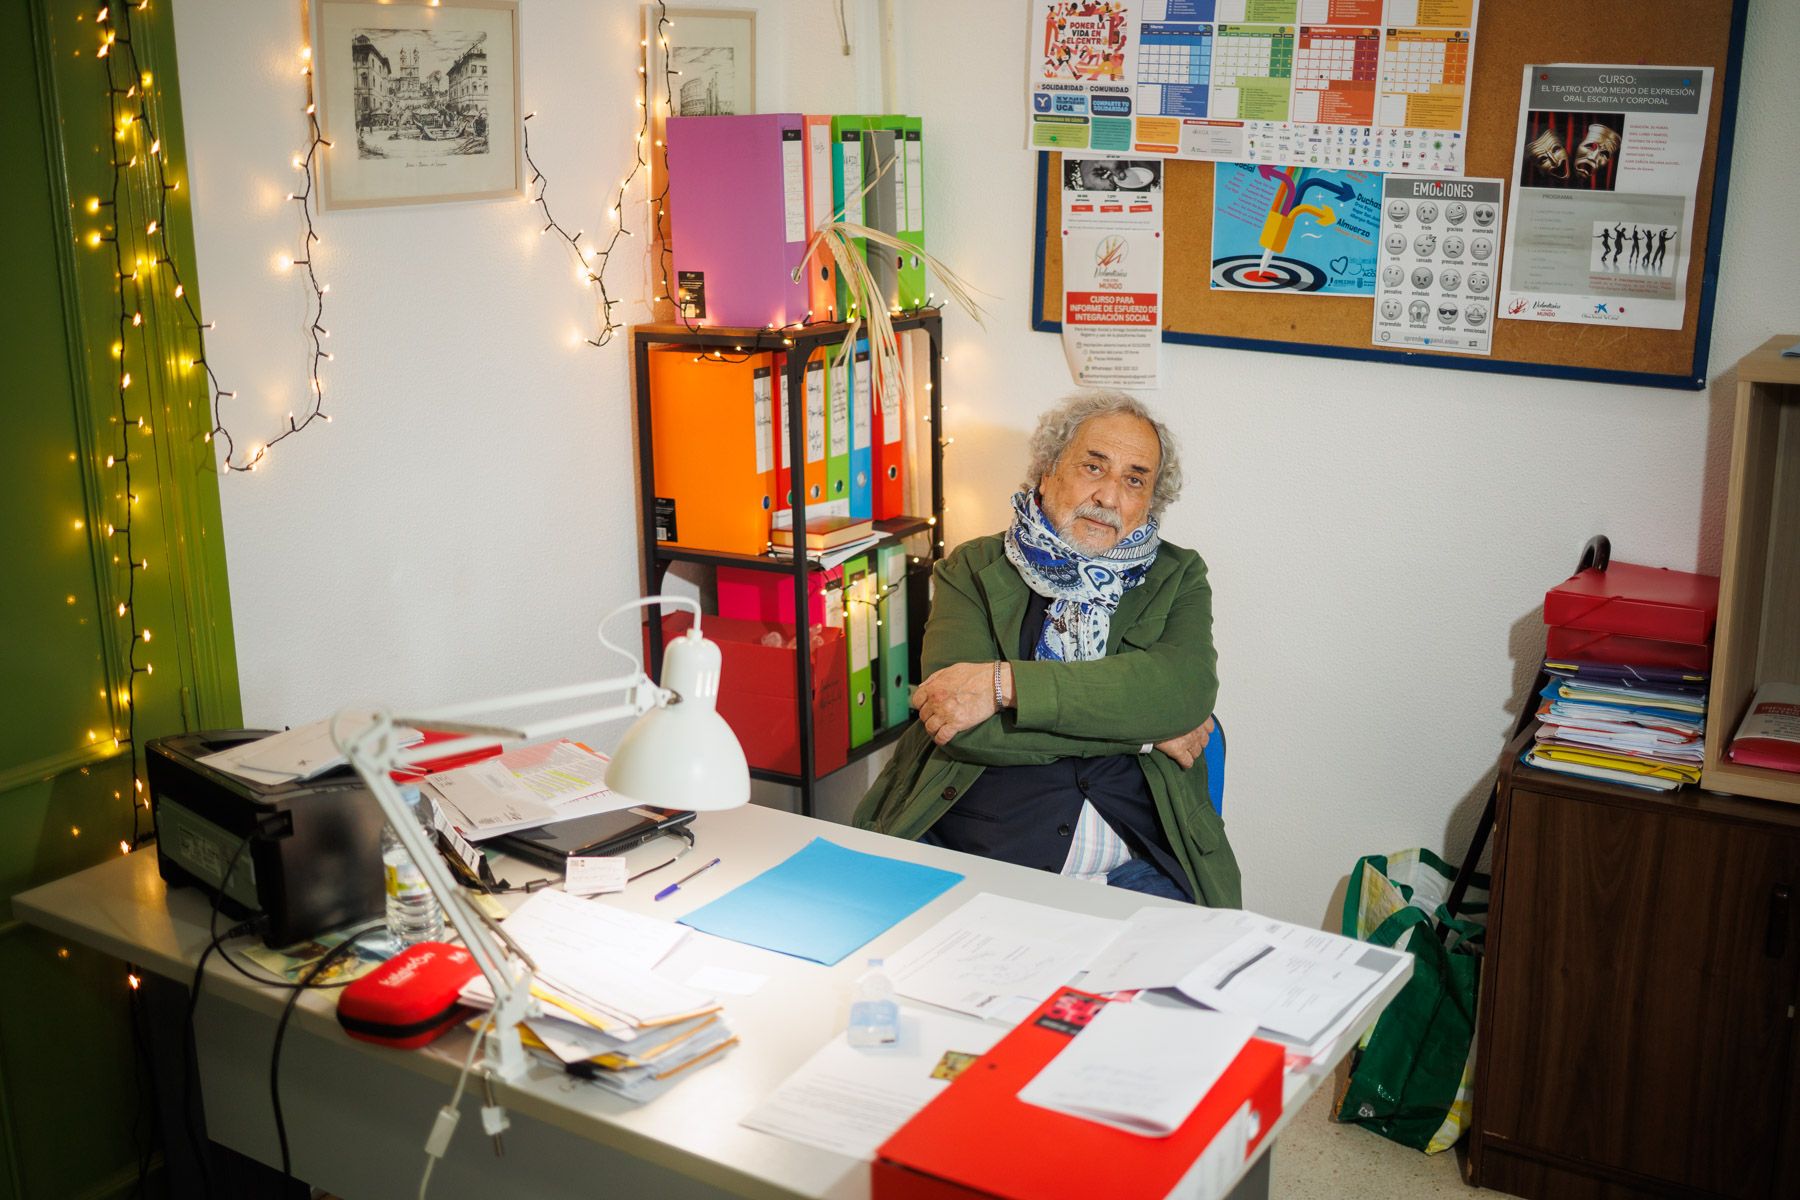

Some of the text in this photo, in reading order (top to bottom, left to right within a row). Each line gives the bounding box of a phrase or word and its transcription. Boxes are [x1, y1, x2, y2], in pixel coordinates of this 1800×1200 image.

[1598, 74, 1637, 84] CURSO:
[1042, 84, 1084, 92] SOLIDARIDAD
[1090, 85, 1130, 93] COMUNIDAD
[1582, 86, 1608, 94] COMO
[1610, 86, 1636, 94] MEDIO
[1650, 88, 1695, 96] EXPRESIÓN
[1626, 97, 1668, 105] CORPORAL
[1413, 182, 1474, 198] EMOCIONES
[1357, 193, 1382, 210] Duchas
[1336, 218, 1370, 238] Almuerzo
[1090, 296, 1134, 304] CURSO PARA
[1070, 304, 1102, 312] INFORME
[1114, 306, 1148, 314] ESFUERZO
[1075, 312, 1150, 322] INTEGRACIÓN SOCIAL
